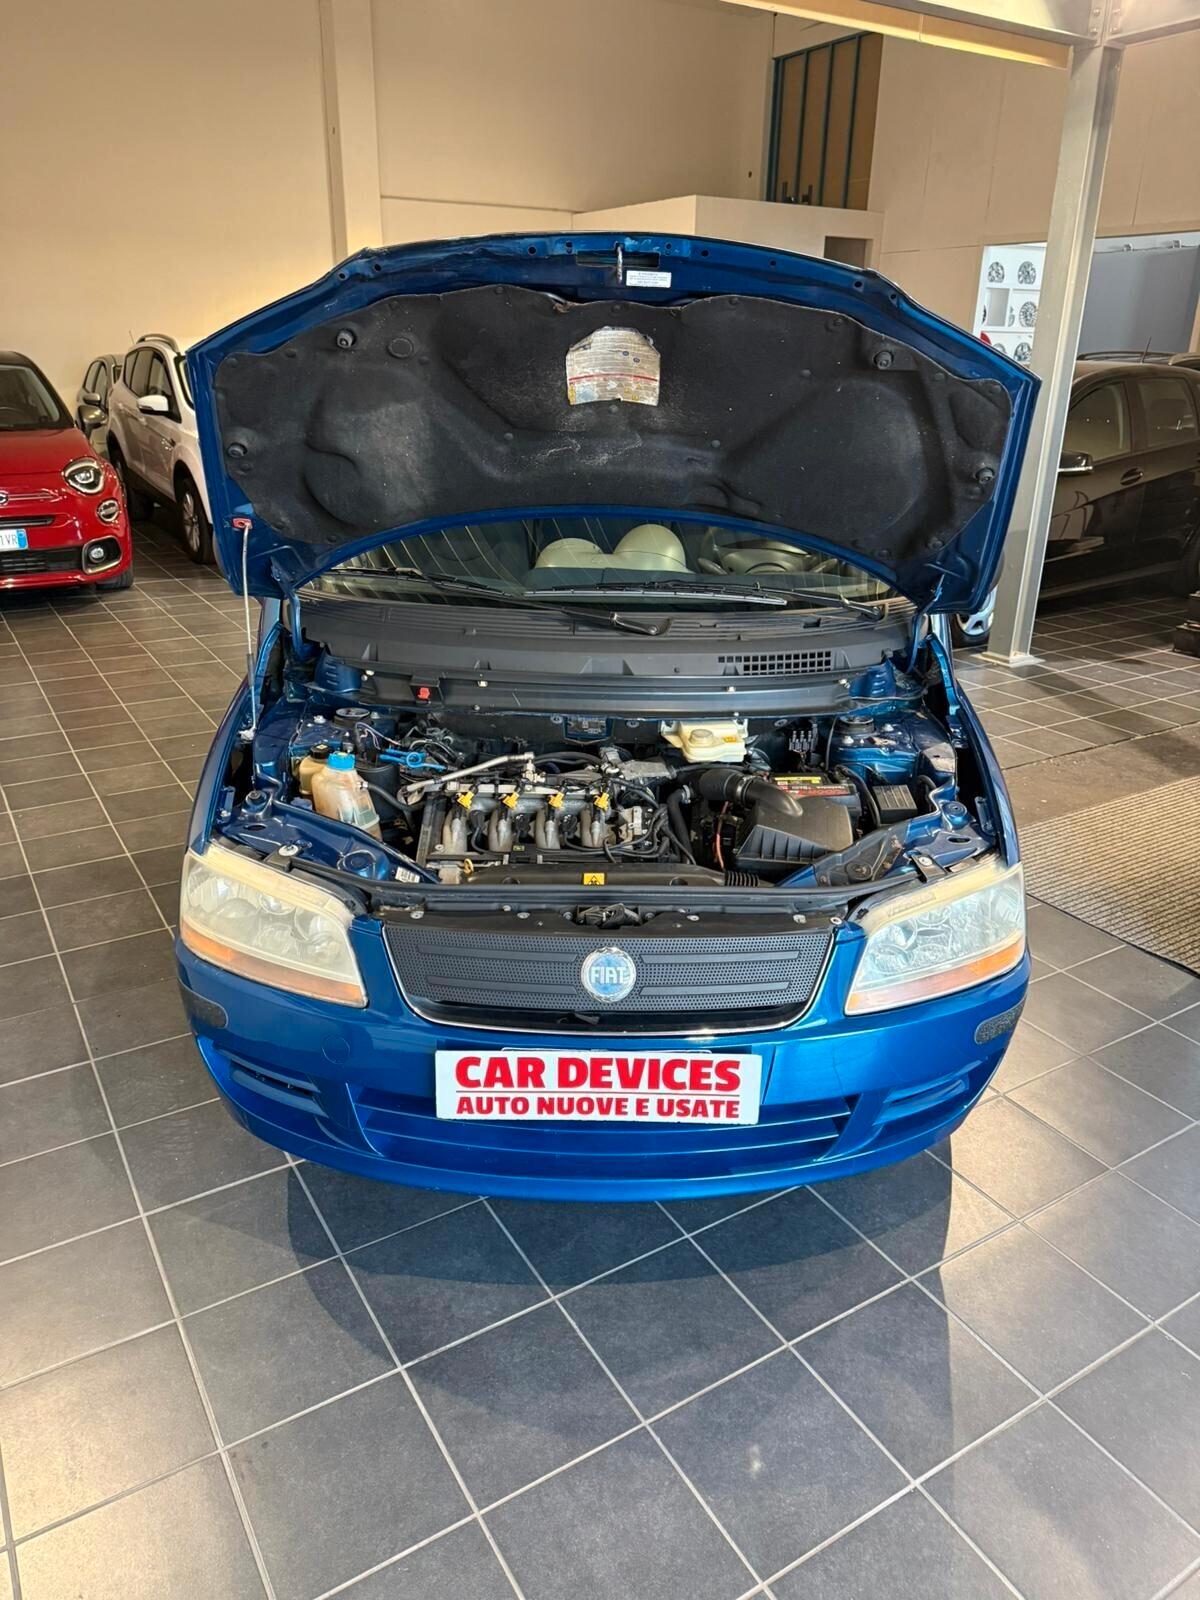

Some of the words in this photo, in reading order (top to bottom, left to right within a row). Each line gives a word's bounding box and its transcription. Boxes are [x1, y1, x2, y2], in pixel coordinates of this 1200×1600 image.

[591, 966, 627, 985] FIAT
[455, 1056, 545, 1088] CAR
[557, 1057, 741, 1092] DEVICES
[456, 1096, 530, 1115] AUTO
[537, 1097, 629, 1116] NUOVE
[636, 1098, 650, 1116] E
[657, 1098, 740, 1119] USATE
